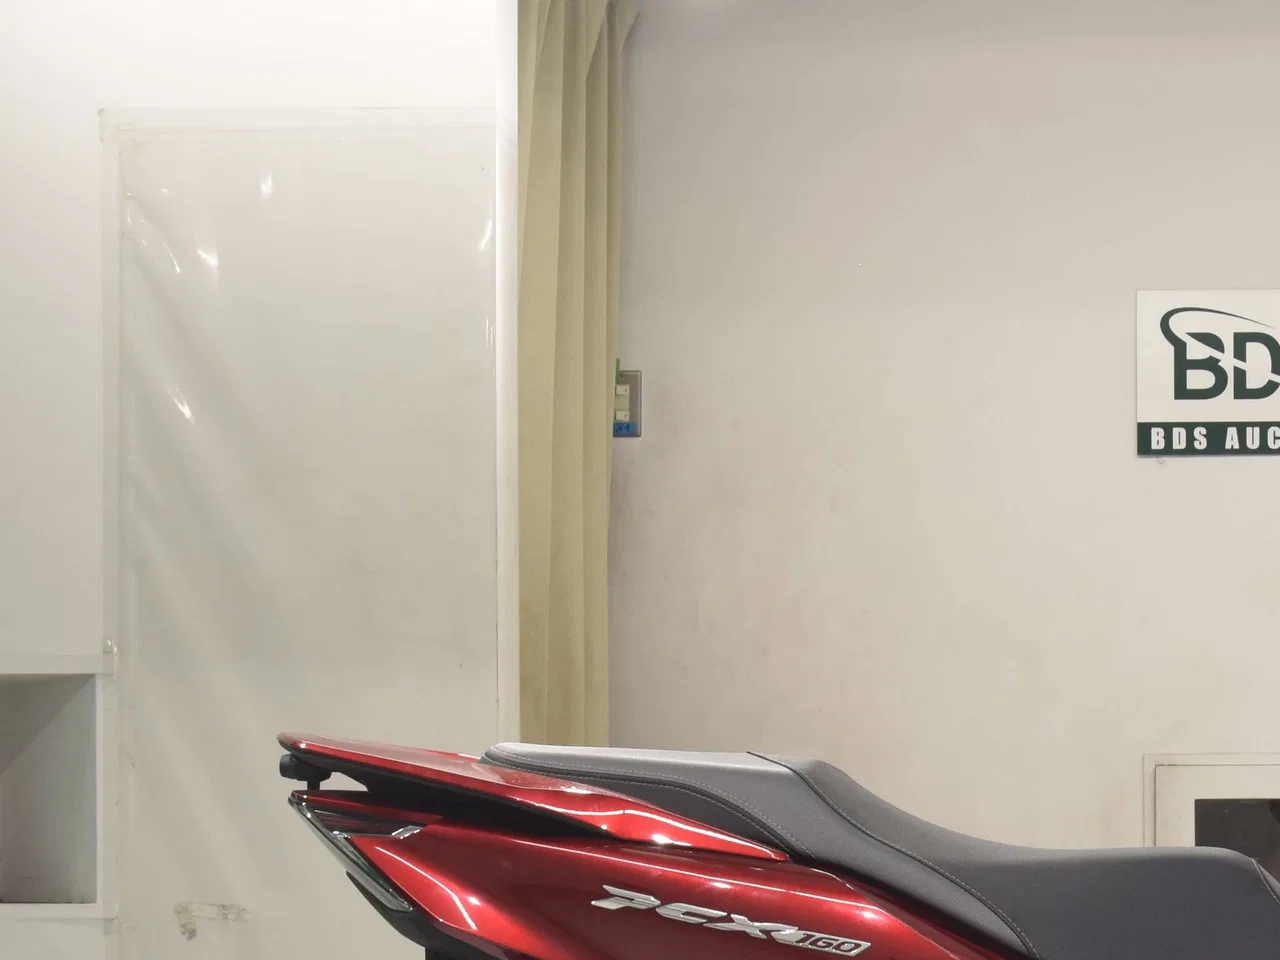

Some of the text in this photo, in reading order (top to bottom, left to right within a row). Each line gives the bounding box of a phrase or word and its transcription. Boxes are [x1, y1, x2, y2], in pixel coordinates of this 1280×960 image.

[1150, 426, 1208, 451] BDS
[590, 884, 864, 955] PCX 160
